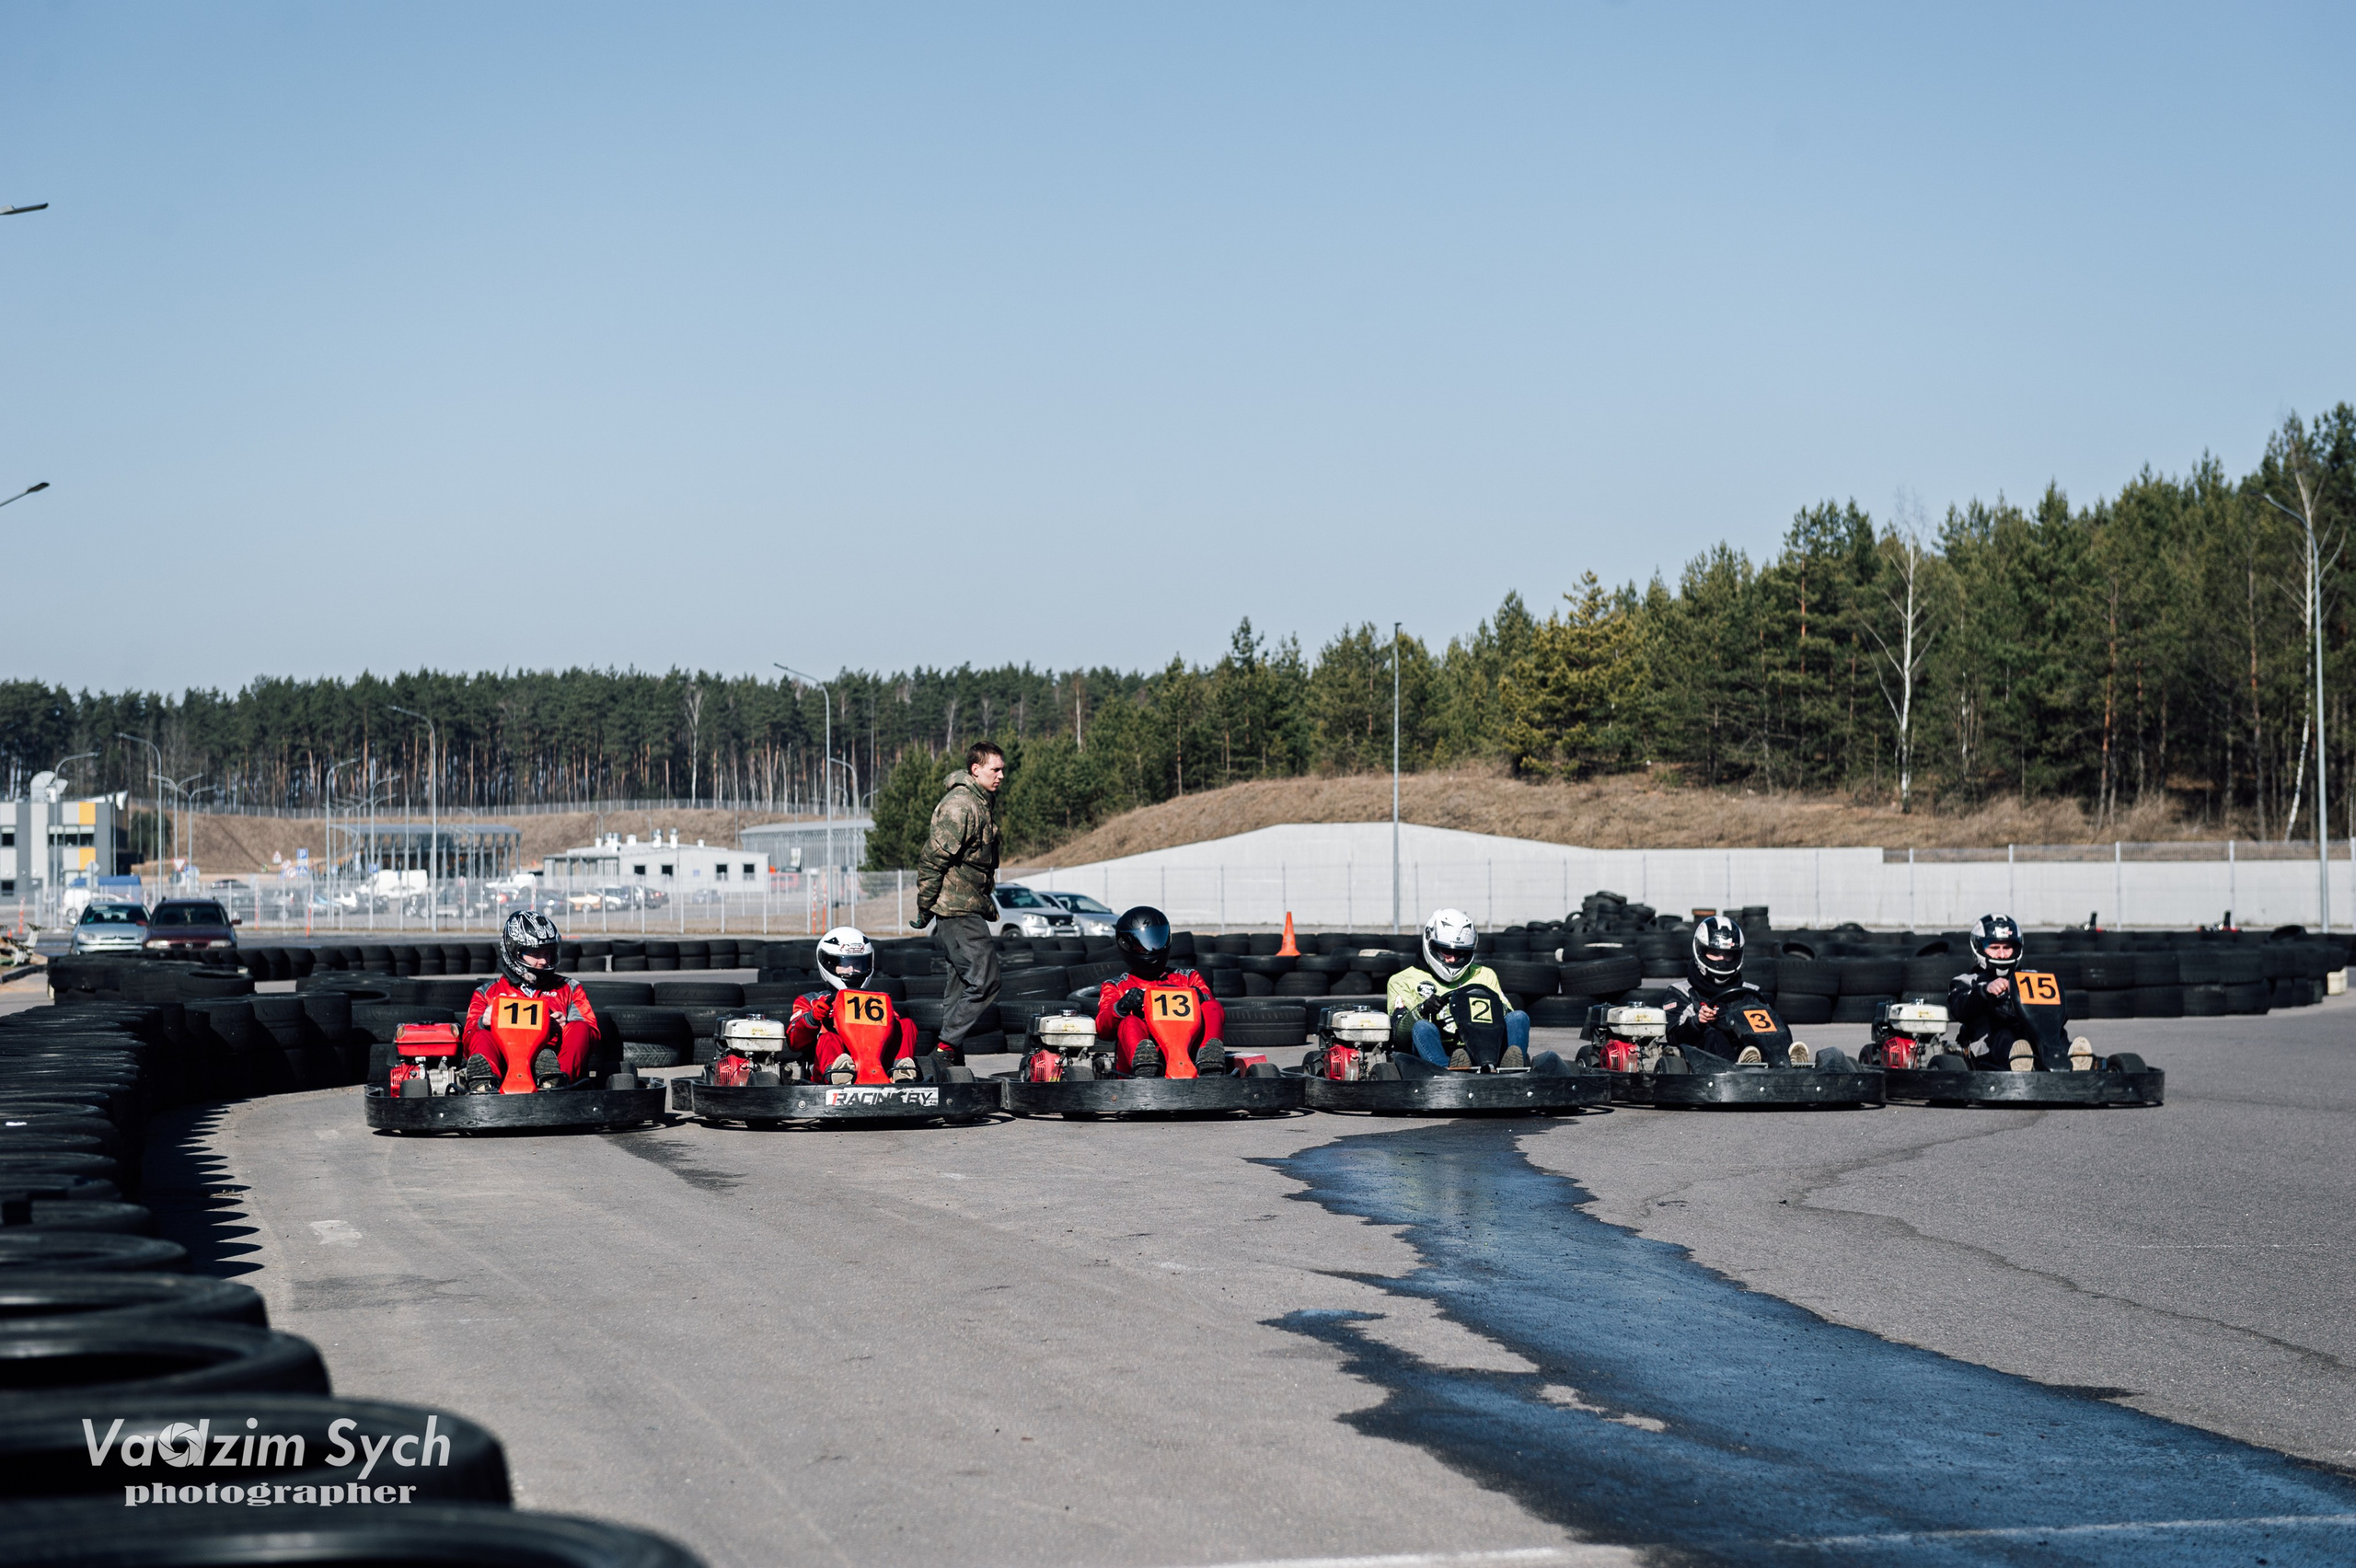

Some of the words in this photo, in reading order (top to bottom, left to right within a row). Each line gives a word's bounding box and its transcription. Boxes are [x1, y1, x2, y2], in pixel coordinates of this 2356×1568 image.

[2019, 975, 2056, 999] 15
[503, 1002, 538, 1025] 11
[847, 996, 884, 1021] 16
[1154, 994, 1191, 1017] 13
[1472, 999, 1492, 1021] 2
[1750, 1013, 1772, 1029] 3
